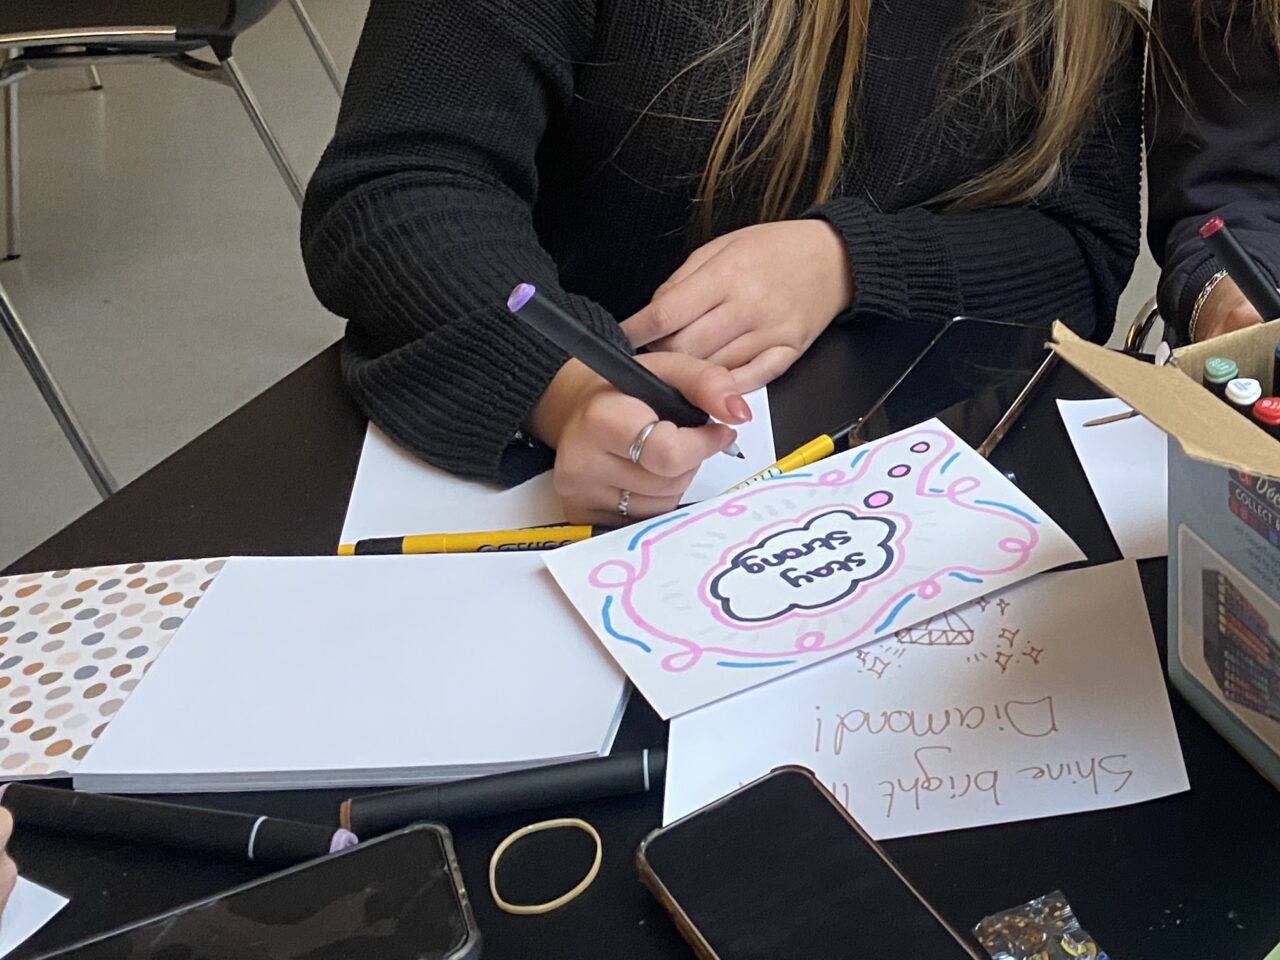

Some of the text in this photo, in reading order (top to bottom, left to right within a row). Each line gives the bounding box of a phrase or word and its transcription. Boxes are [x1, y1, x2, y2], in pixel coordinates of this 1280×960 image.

[1235, 488, 1272, 524] COLLECT
[739, 531, 851, 574] strong
[780, 552, 866, 588] stay
[814, 696, 1059, 755] Diamond!
[879, 746, 1000, 818] bright
[1015, 754, 1133, 795] Shine
